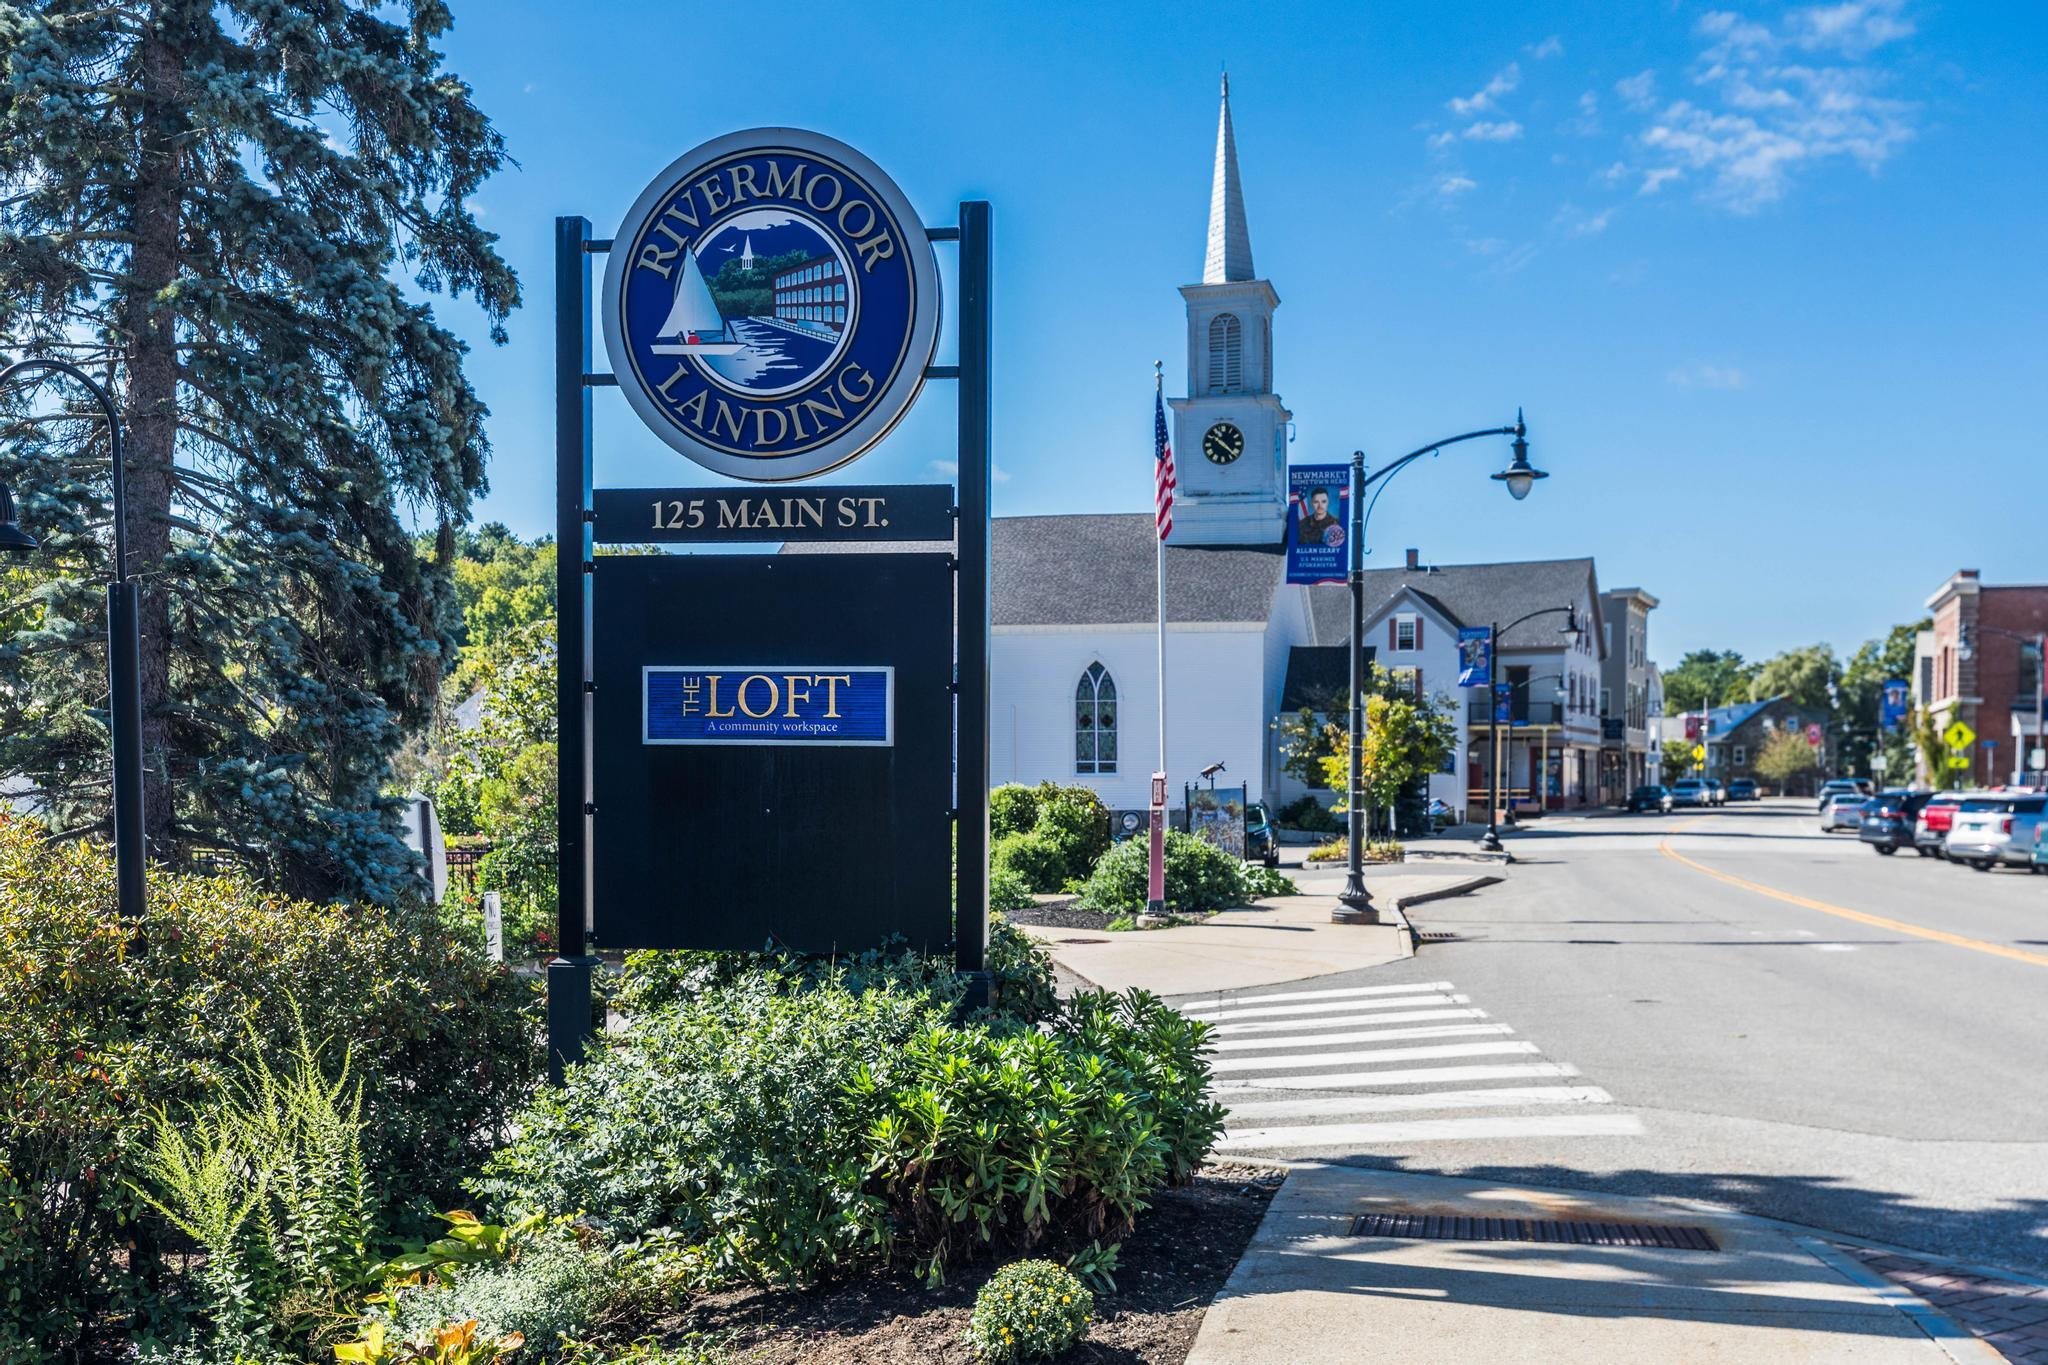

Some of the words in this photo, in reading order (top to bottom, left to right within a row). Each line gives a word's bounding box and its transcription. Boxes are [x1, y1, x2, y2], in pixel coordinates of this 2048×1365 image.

[637, 160, 895, 280] RIVERMOOR
[656, 361, 875, 446] LANDING
[1291, 471, 1347, 479] NEWMARKET
[651, 499, 705, 529] 125
[716, 497, 827, 529] MAIN
[837, 497, 889, 528] ST.
[683, 676, 700, 717] THE
[704, 674, 851, 718] LOFT
[707, 721, 716, 731] A
[719, 721, 780, 734] community
[782, 721, 838, 734] workspace
